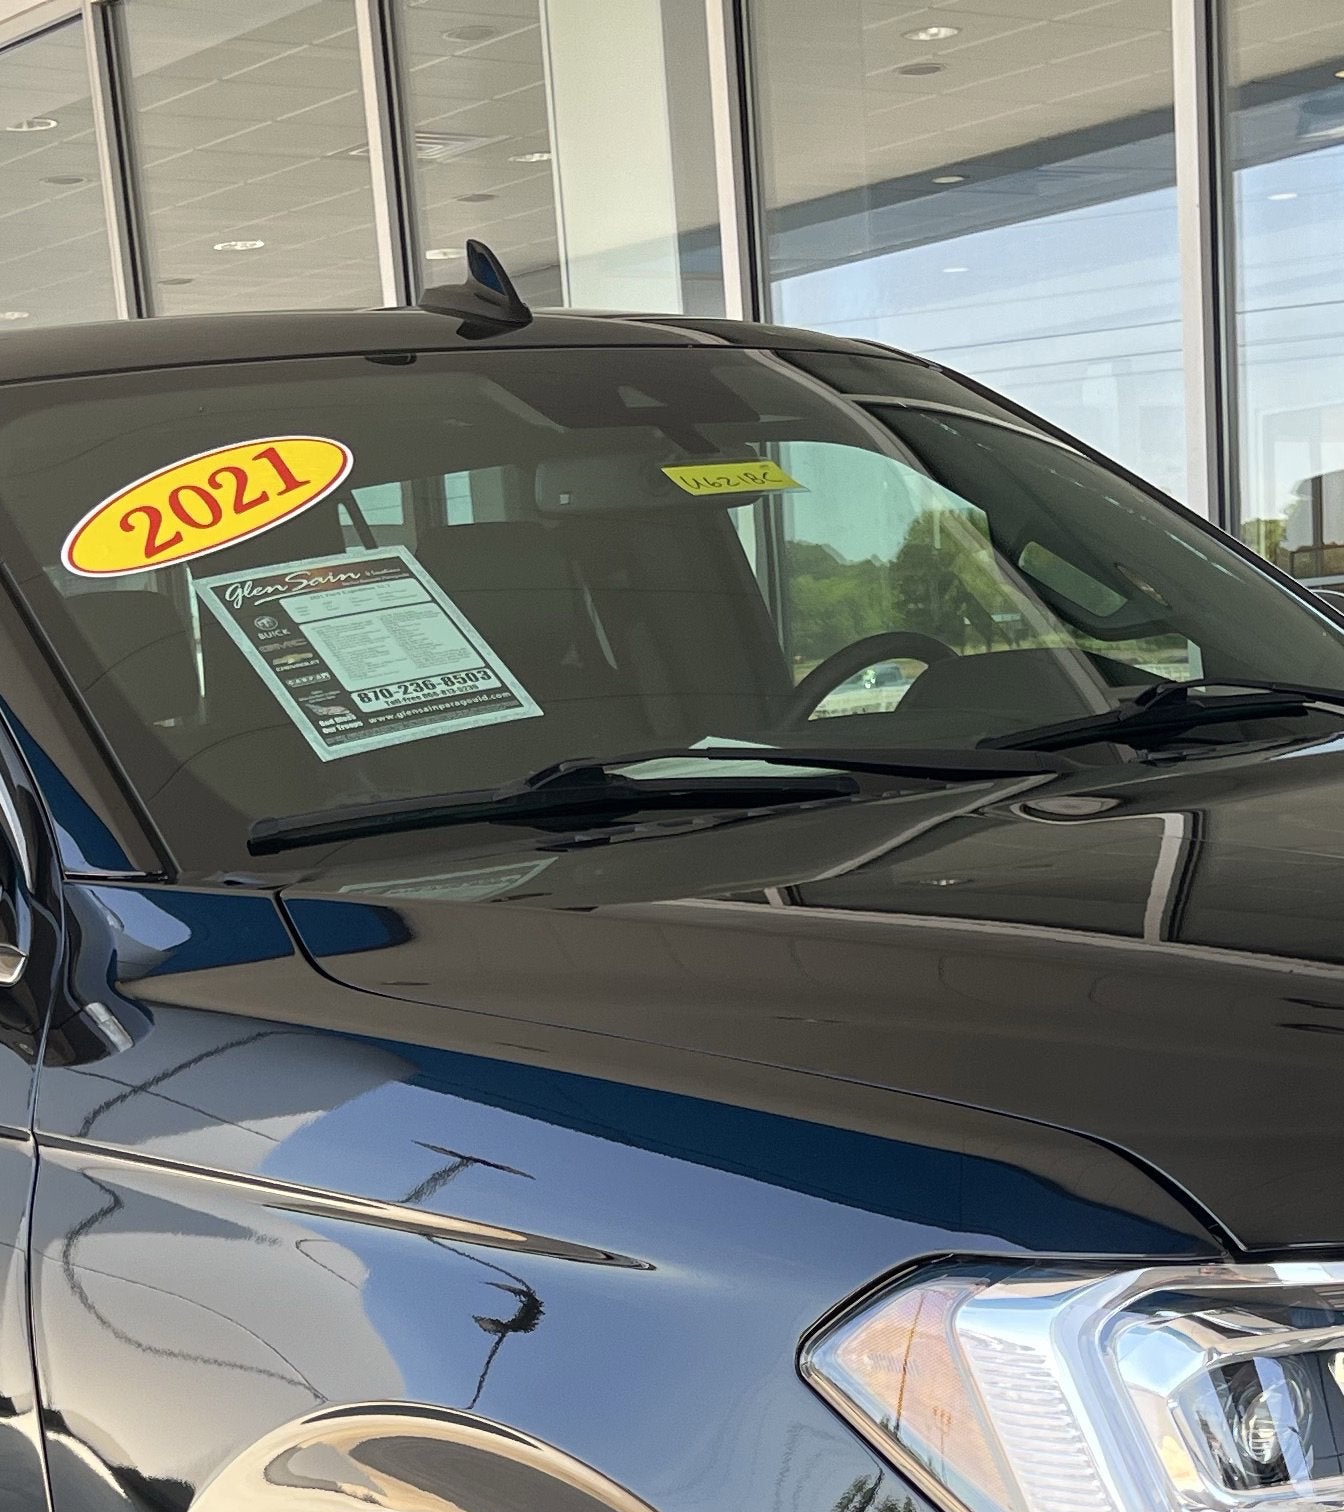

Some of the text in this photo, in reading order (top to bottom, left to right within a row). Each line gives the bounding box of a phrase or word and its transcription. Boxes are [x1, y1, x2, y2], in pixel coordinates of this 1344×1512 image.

[120, 447, 311, 558] 2021
[224, 580, 289, 609] Glen
[285, 571, 360, 592] Sain
[257, 628, 291, 640] BUICK
[357, 669, 493, 704] 870-236-8503
[368, 692, 512, 724] www.glensainparagould.com
